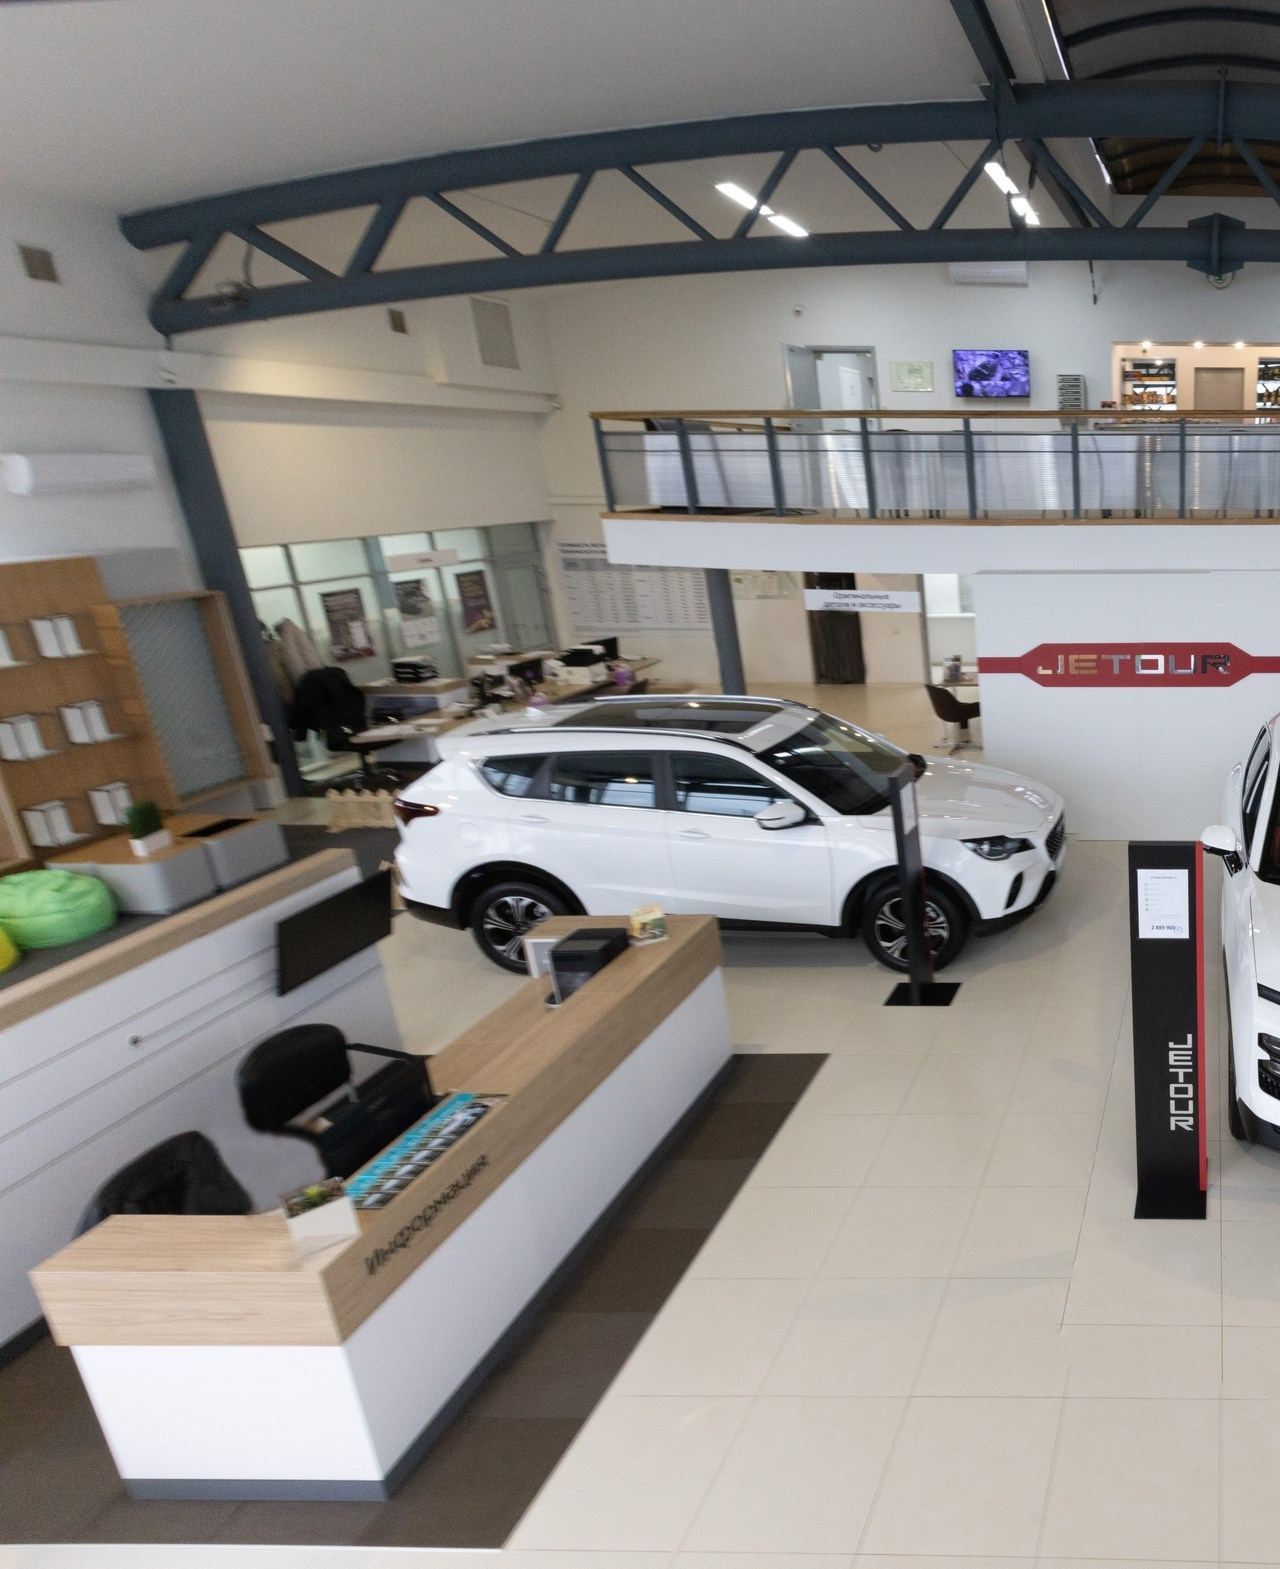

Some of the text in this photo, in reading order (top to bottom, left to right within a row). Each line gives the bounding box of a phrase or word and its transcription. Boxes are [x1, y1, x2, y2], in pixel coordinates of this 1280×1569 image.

[1036, 654, 1231, 675] JETOUR
[1168, 1033, 1194, 1131] JETOUR
[364, 1153, 490, 1276] Информация
